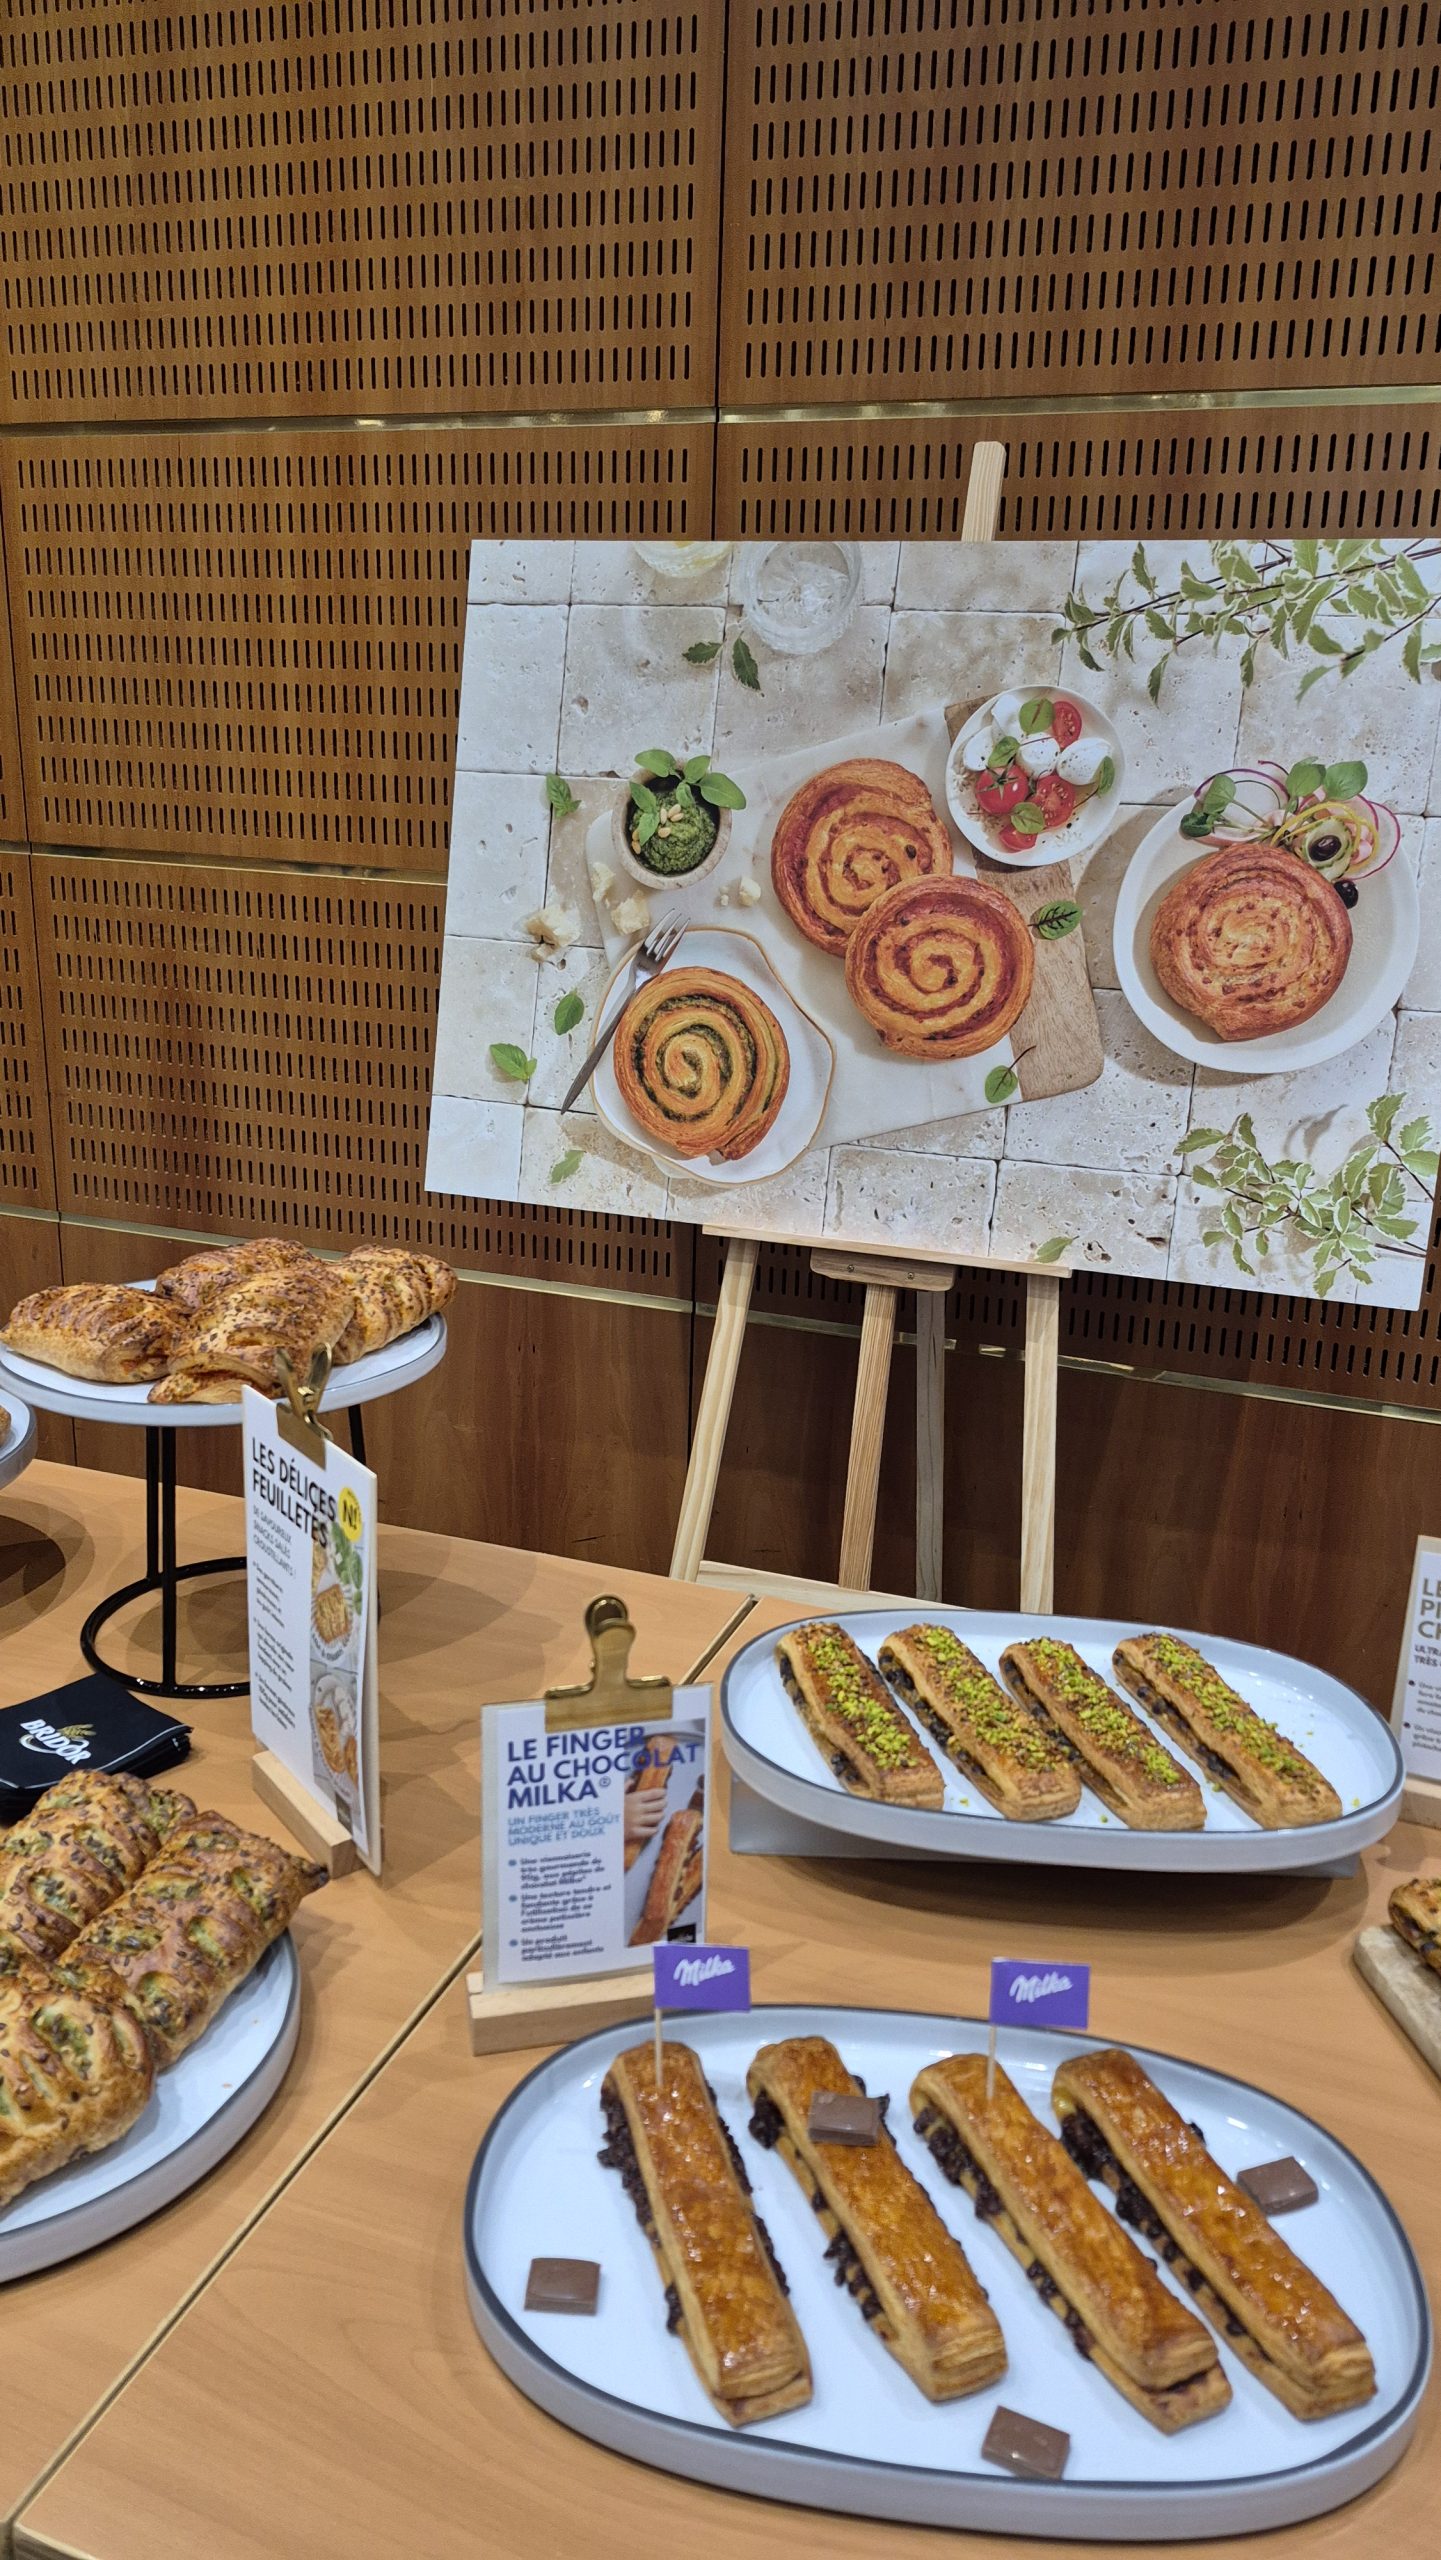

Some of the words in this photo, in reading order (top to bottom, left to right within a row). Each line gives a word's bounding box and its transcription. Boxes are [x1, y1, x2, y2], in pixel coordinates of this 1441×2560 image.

[252, 1436, 275, 1475] LES
[279, 1457, 337, 1522] DÉLICES
[253, 1468, 328, 1549] FEUILLETÉS
[20, 1719, 92, 1765] BRIDOR
[508, 1738, 538, 1762] LE
[547, 1726, 645, 1757] FINGER
[507, 1763, 546, 1786] AU
[554, 1744, 700, 1780] CHOCOLAT
[508, 1816, 526, 1826] UN
[529, 1811, 569, 1823] FINGER
[573, 1807, 600, 1819] TRÈS
[508, 1823, 565, 1835] MODERNE
[569, 1819, 585, 1829] AU
[588, 1812, 620, 1826] GOÛT
[508, 1834, 552, 1846] UNIQUE
[556, 1831, 568, 1841] ET
[571, 1827, 605, 1839] DOUX
[673, 1954, 736, 1987] Milka
[1009, 1971, 1073, 2003] Milka
